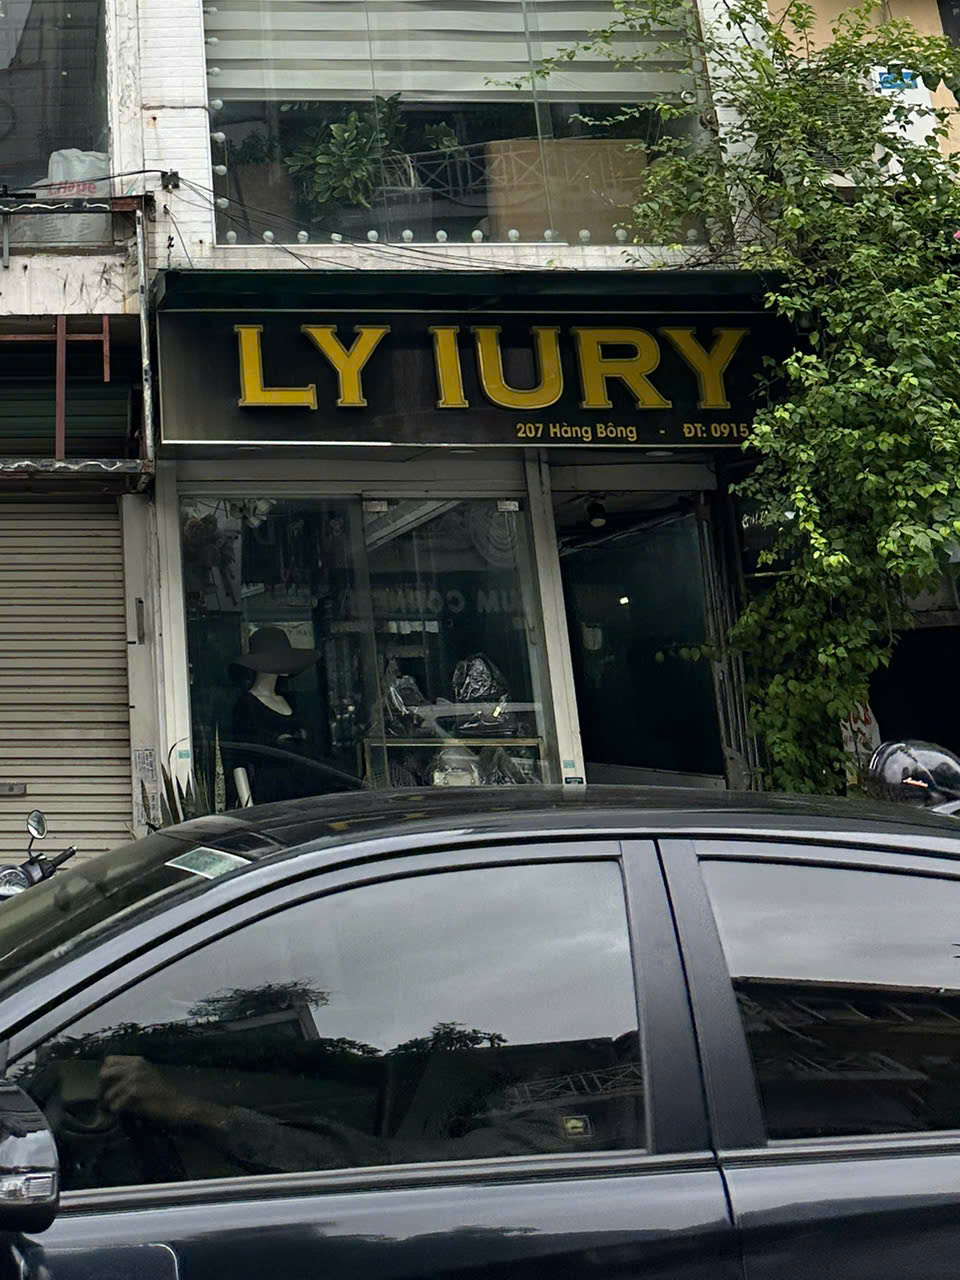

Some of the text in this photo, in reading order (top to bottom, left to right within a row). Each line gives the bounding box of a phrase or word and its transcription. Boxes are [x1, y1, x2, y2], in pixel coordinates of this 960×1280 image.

[233, 323, 751, 411] LY IURY
[516, 423, 544, 438] 207
[549, 422, 592, 441] Hàng
[596, 422, 637, 441] Bông
[683, 423, 707, 438] ĐT:
[711, 423, 750, 438] 0915
